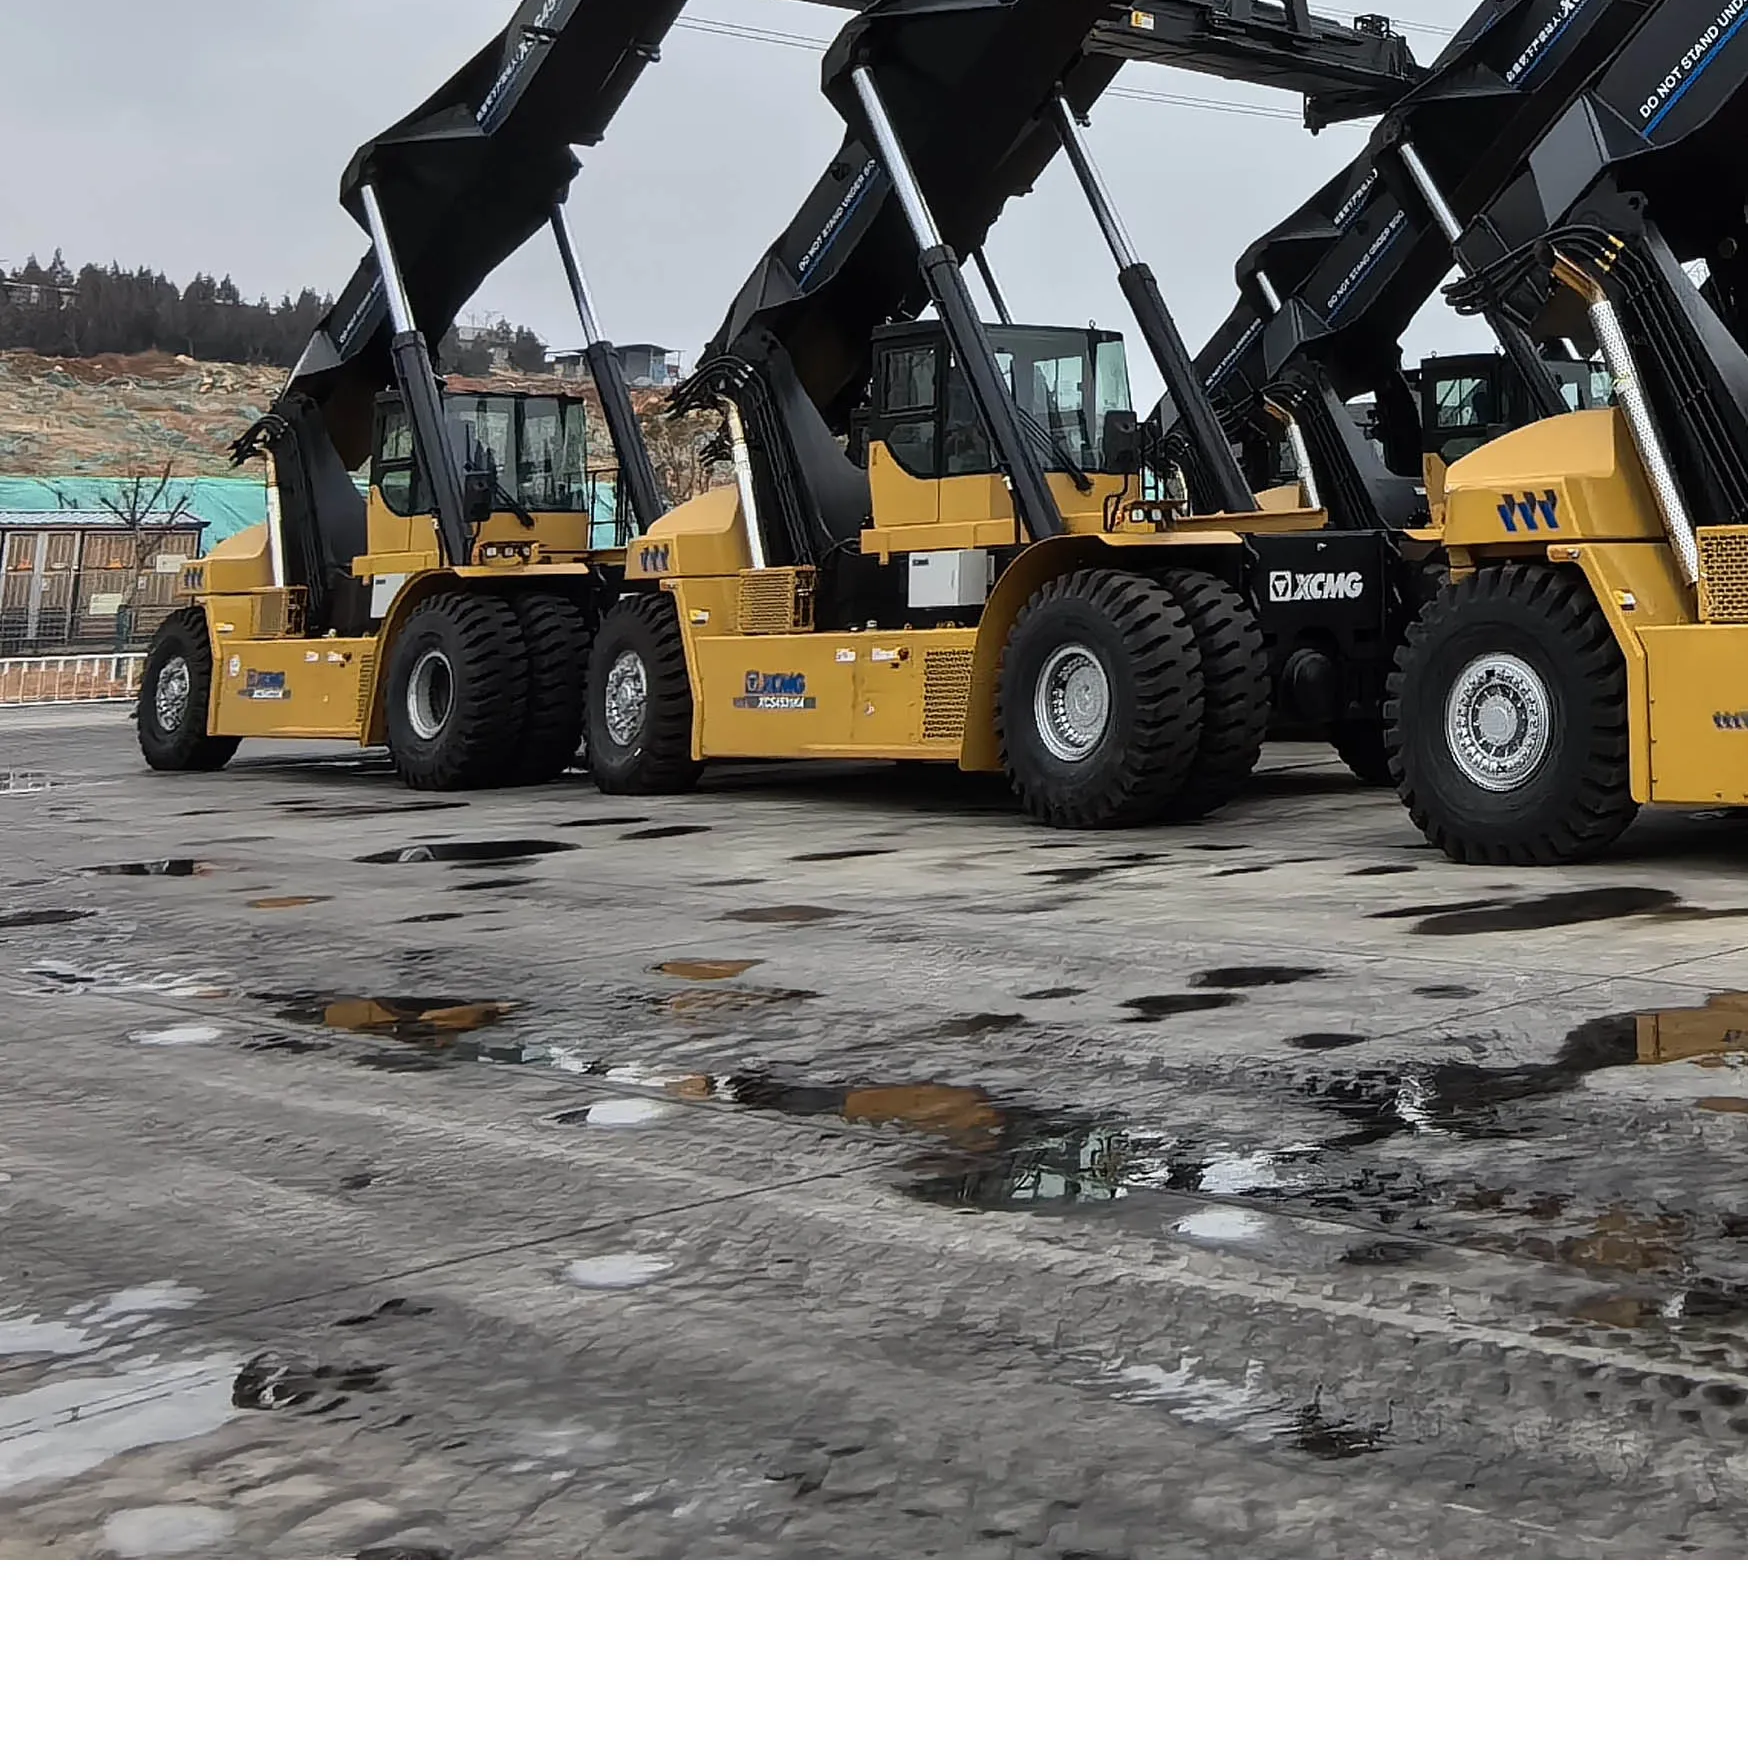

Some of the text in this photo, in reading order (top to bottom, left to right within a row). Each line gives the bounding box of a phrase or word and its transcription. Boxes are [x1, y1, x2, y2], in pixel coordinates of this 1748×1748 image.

[1639, 95, 1660, 119] DO
[1656, 66, 1683, 99] NOT
[1680, 25, 1720, 70] STAND
[1293, 571, 1364, 601] XCMG
